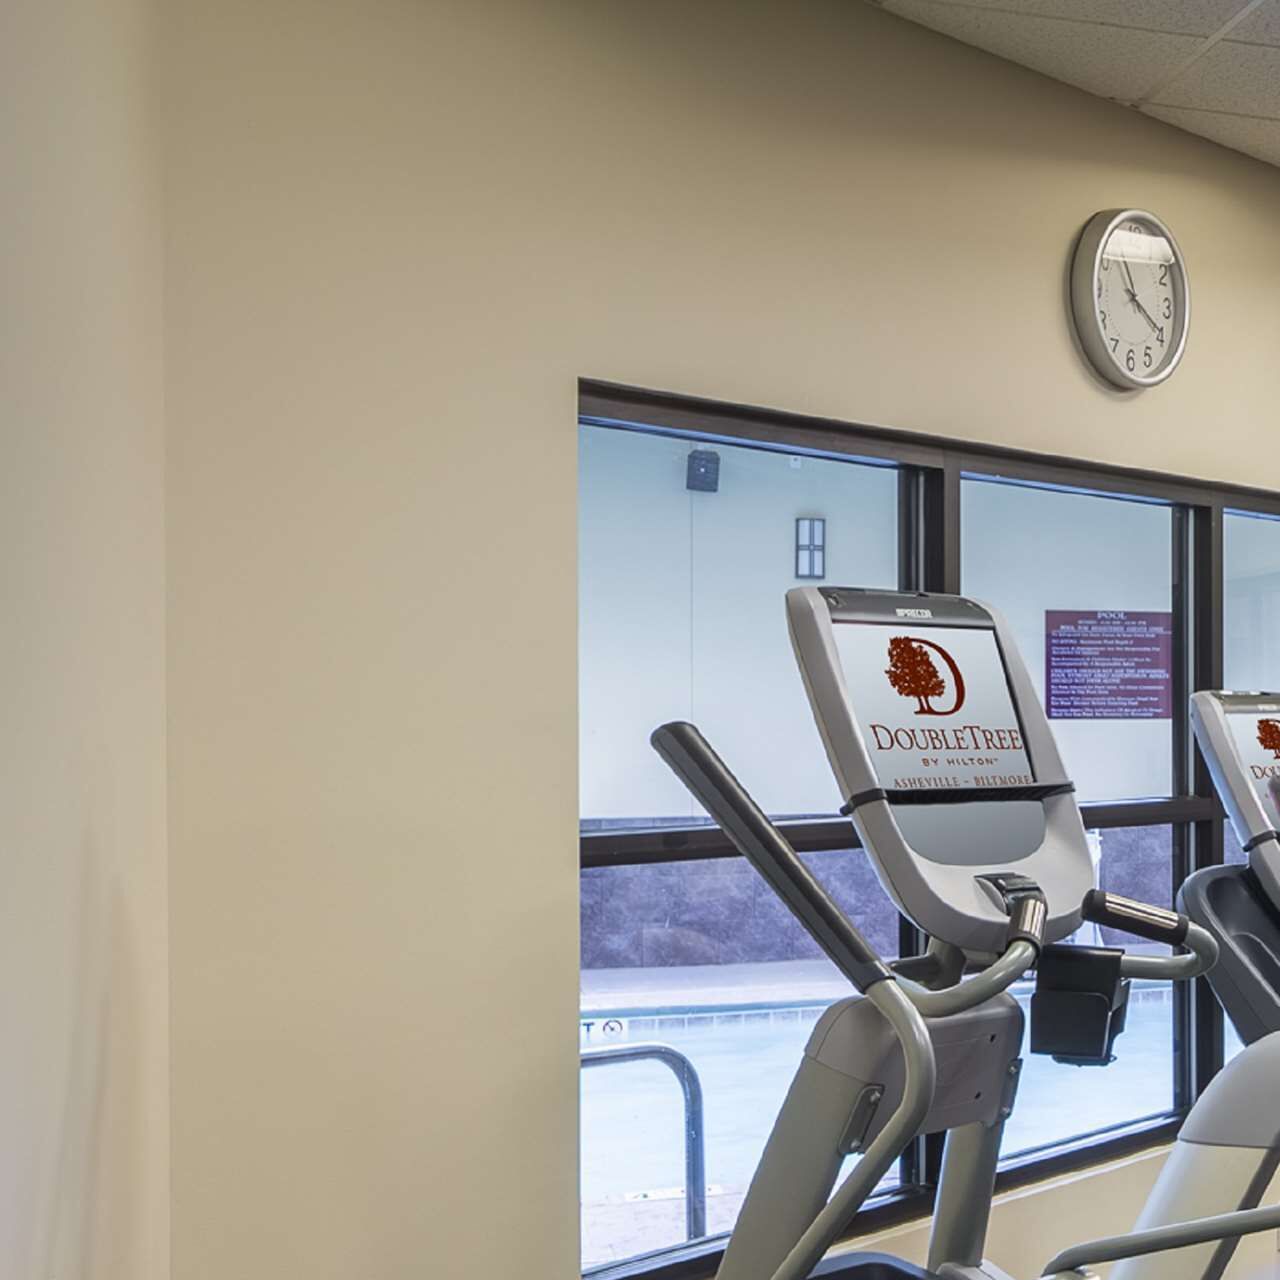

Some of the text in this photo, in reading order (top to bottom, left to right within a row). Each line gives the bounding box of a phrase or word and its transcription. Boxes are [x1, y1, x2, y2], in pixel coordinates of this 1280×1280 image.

[1158, 263, 1168, 287] 2
[1162, 297, 1172, 320] 3
[1110, 337, 1120, 353] 7
[1126, 349, 1136, 372] 6
[1143, 346, 1153, 367] 5
[922, 757, 997, 767] BY HILTON
[894, 776, 961, 789] ASHEVILLE
[974, 774, 1032, 788] BILTMORE
